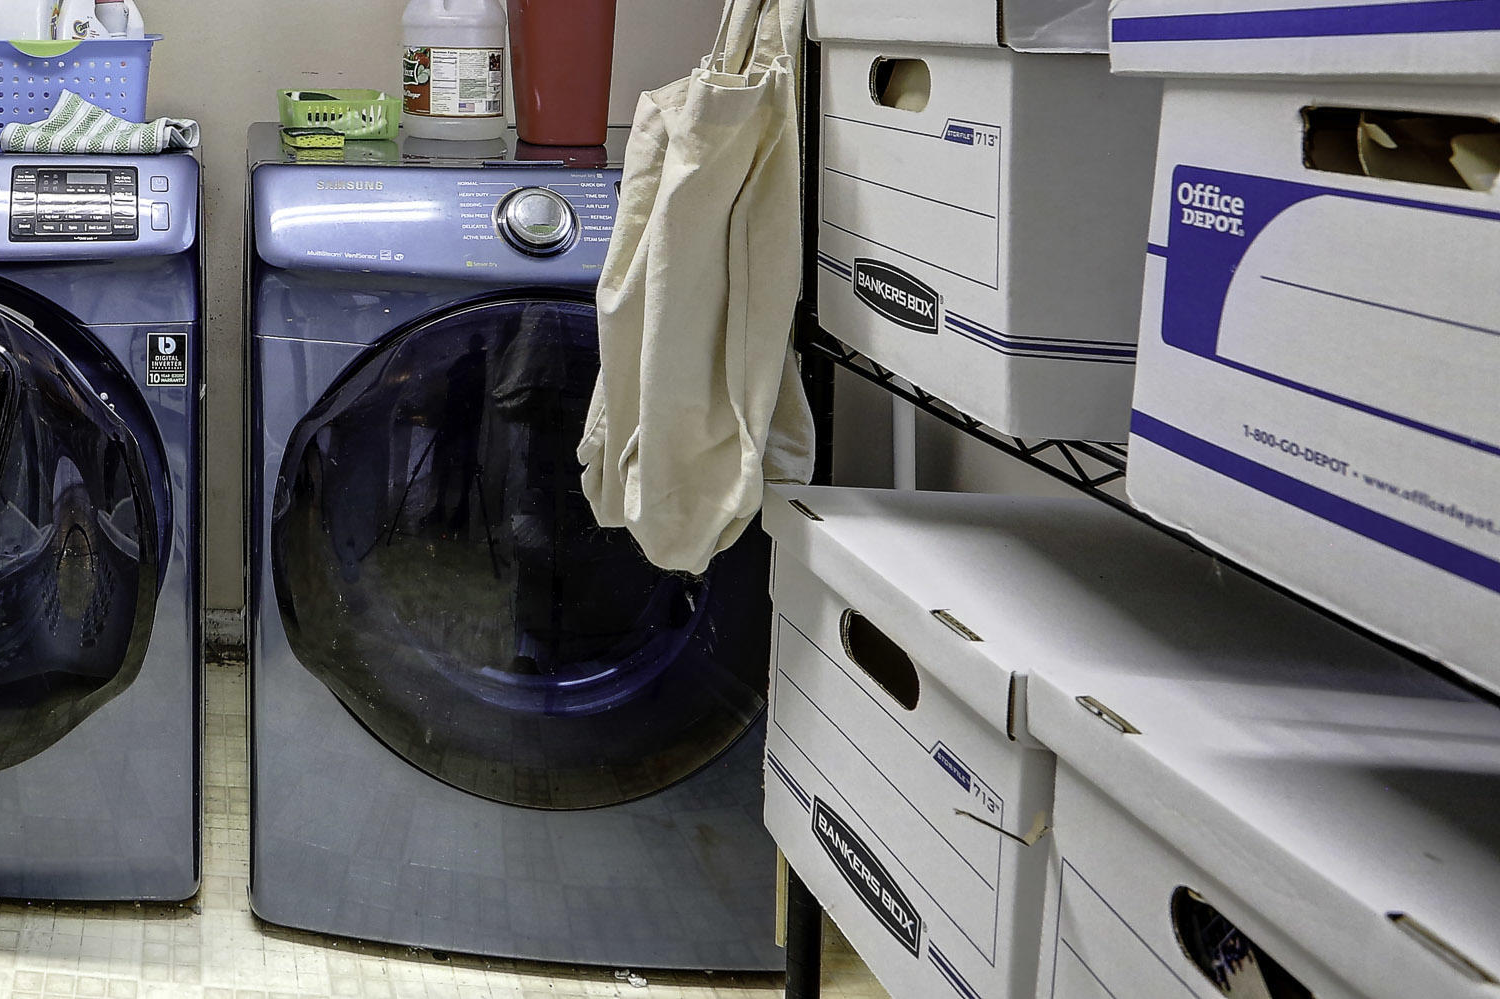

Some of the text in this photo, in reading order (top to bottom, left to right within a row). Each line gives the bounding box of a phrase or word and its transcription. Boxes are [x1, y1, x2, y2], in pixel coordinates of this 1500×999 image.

[976, 131, 995, 147] 713
[316, 180, 385, 191] SAMSUNG
[1177, 182, 1245, 216] Office
[1181, 207, 1243, 236] DEPOT
[858, 271, 934, 320] BANKERS BOX
[149, 373, 161, 383] 10
[1242, 424, 1350, 477] 1-800-GO-DEPOT
[974, 782, 995, 814] 713
[818, 812, 915, 940] BANKERS BOX
